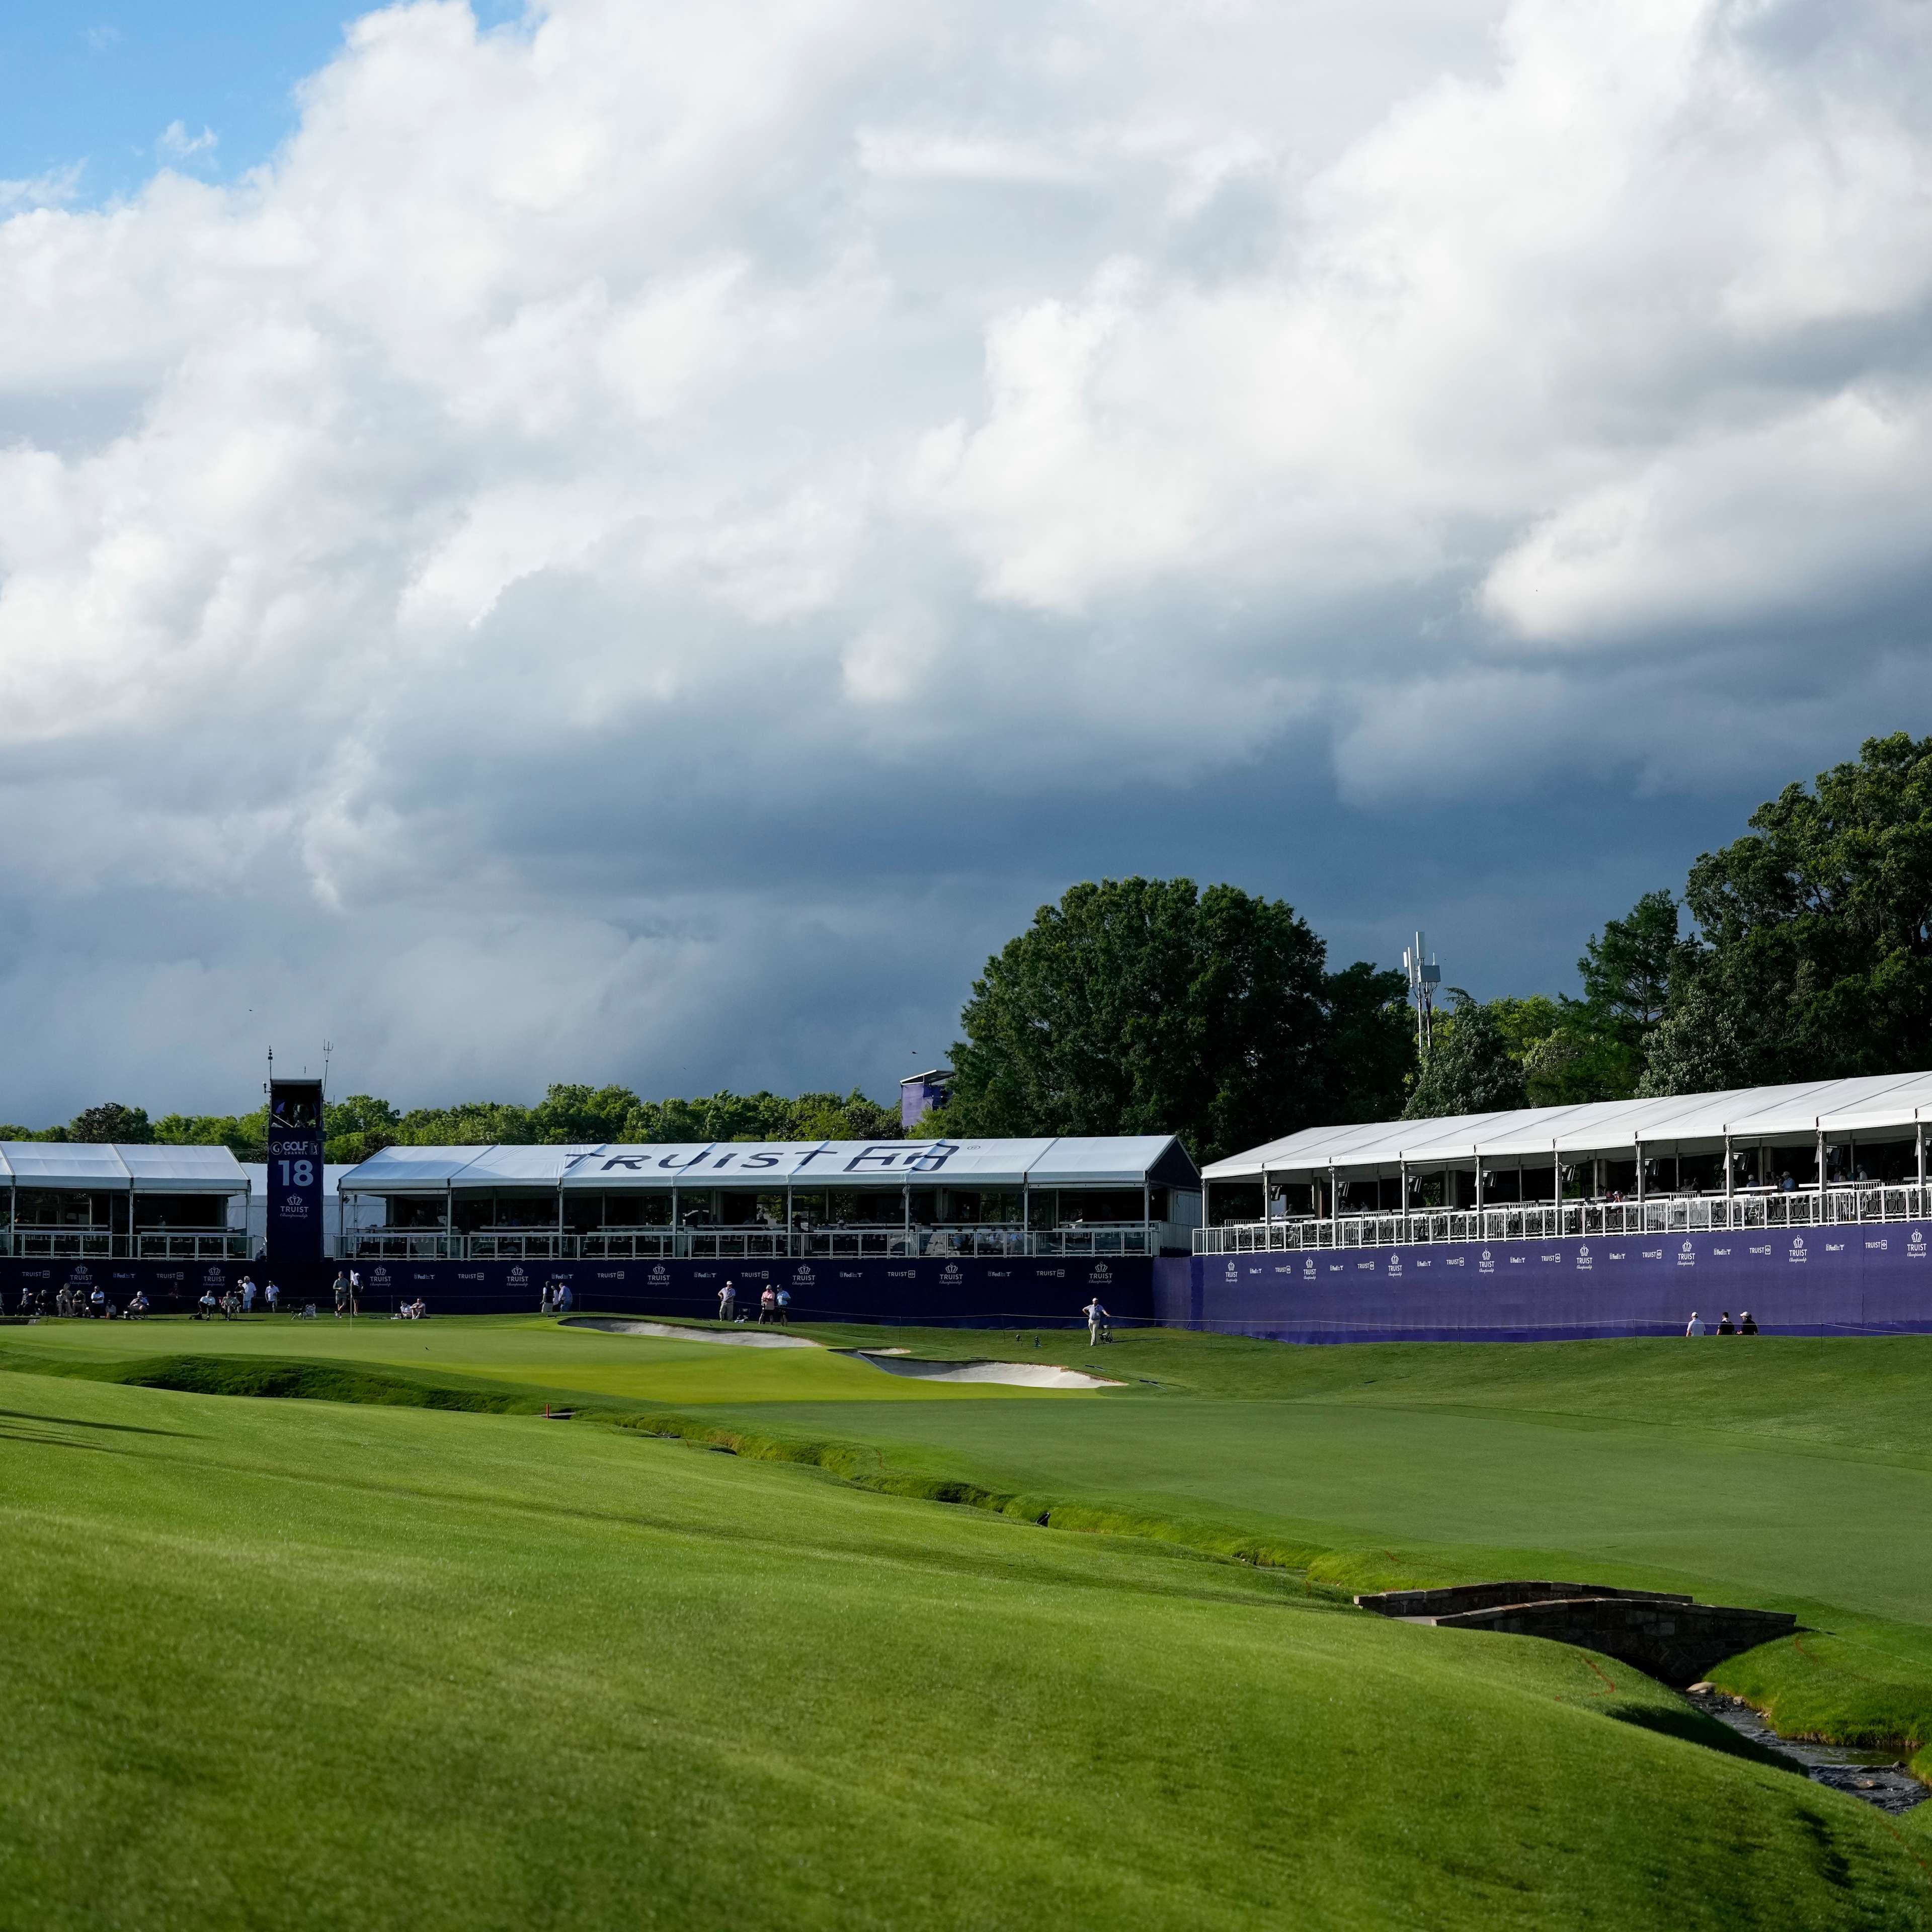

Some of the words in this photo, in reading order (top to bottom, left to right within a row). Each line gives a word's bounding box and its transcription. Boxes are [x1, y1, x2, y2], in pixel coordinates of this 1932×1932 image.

[283, 1142, 308, 1151] GOLF
[564, 1150, 838, 1170] TRUIST
[278, 1160, 313, 1186] 18
